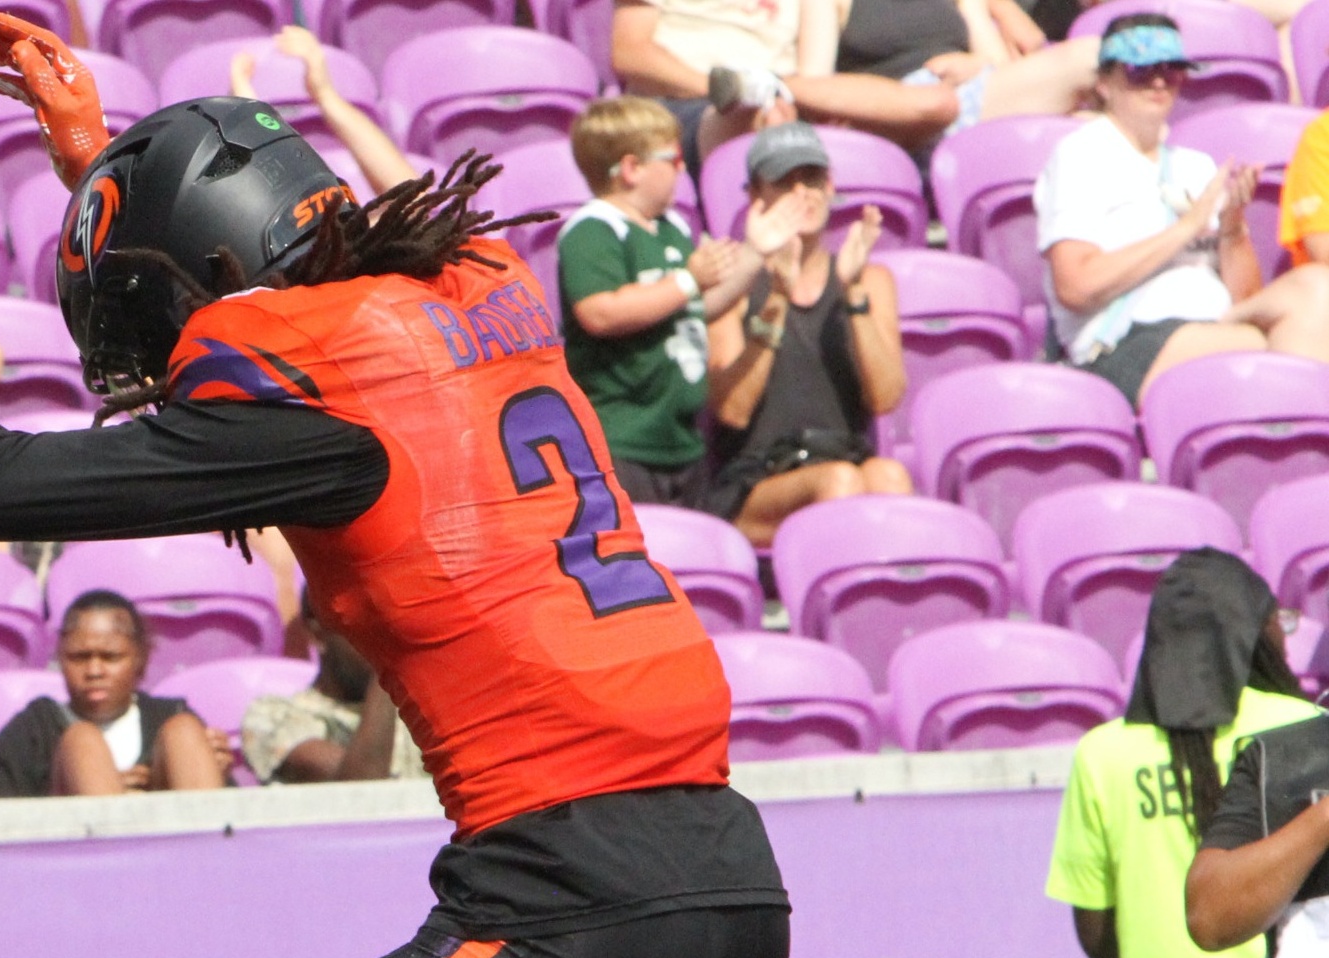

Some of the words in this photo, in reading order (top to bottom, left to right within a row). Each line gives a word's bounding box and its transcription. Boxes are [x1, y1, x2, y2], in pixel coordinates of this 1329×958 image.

[293, 185, 357, 229] ST
[499, 385, 676, 620] 2
[1136, 764, 1194, 820] SE
